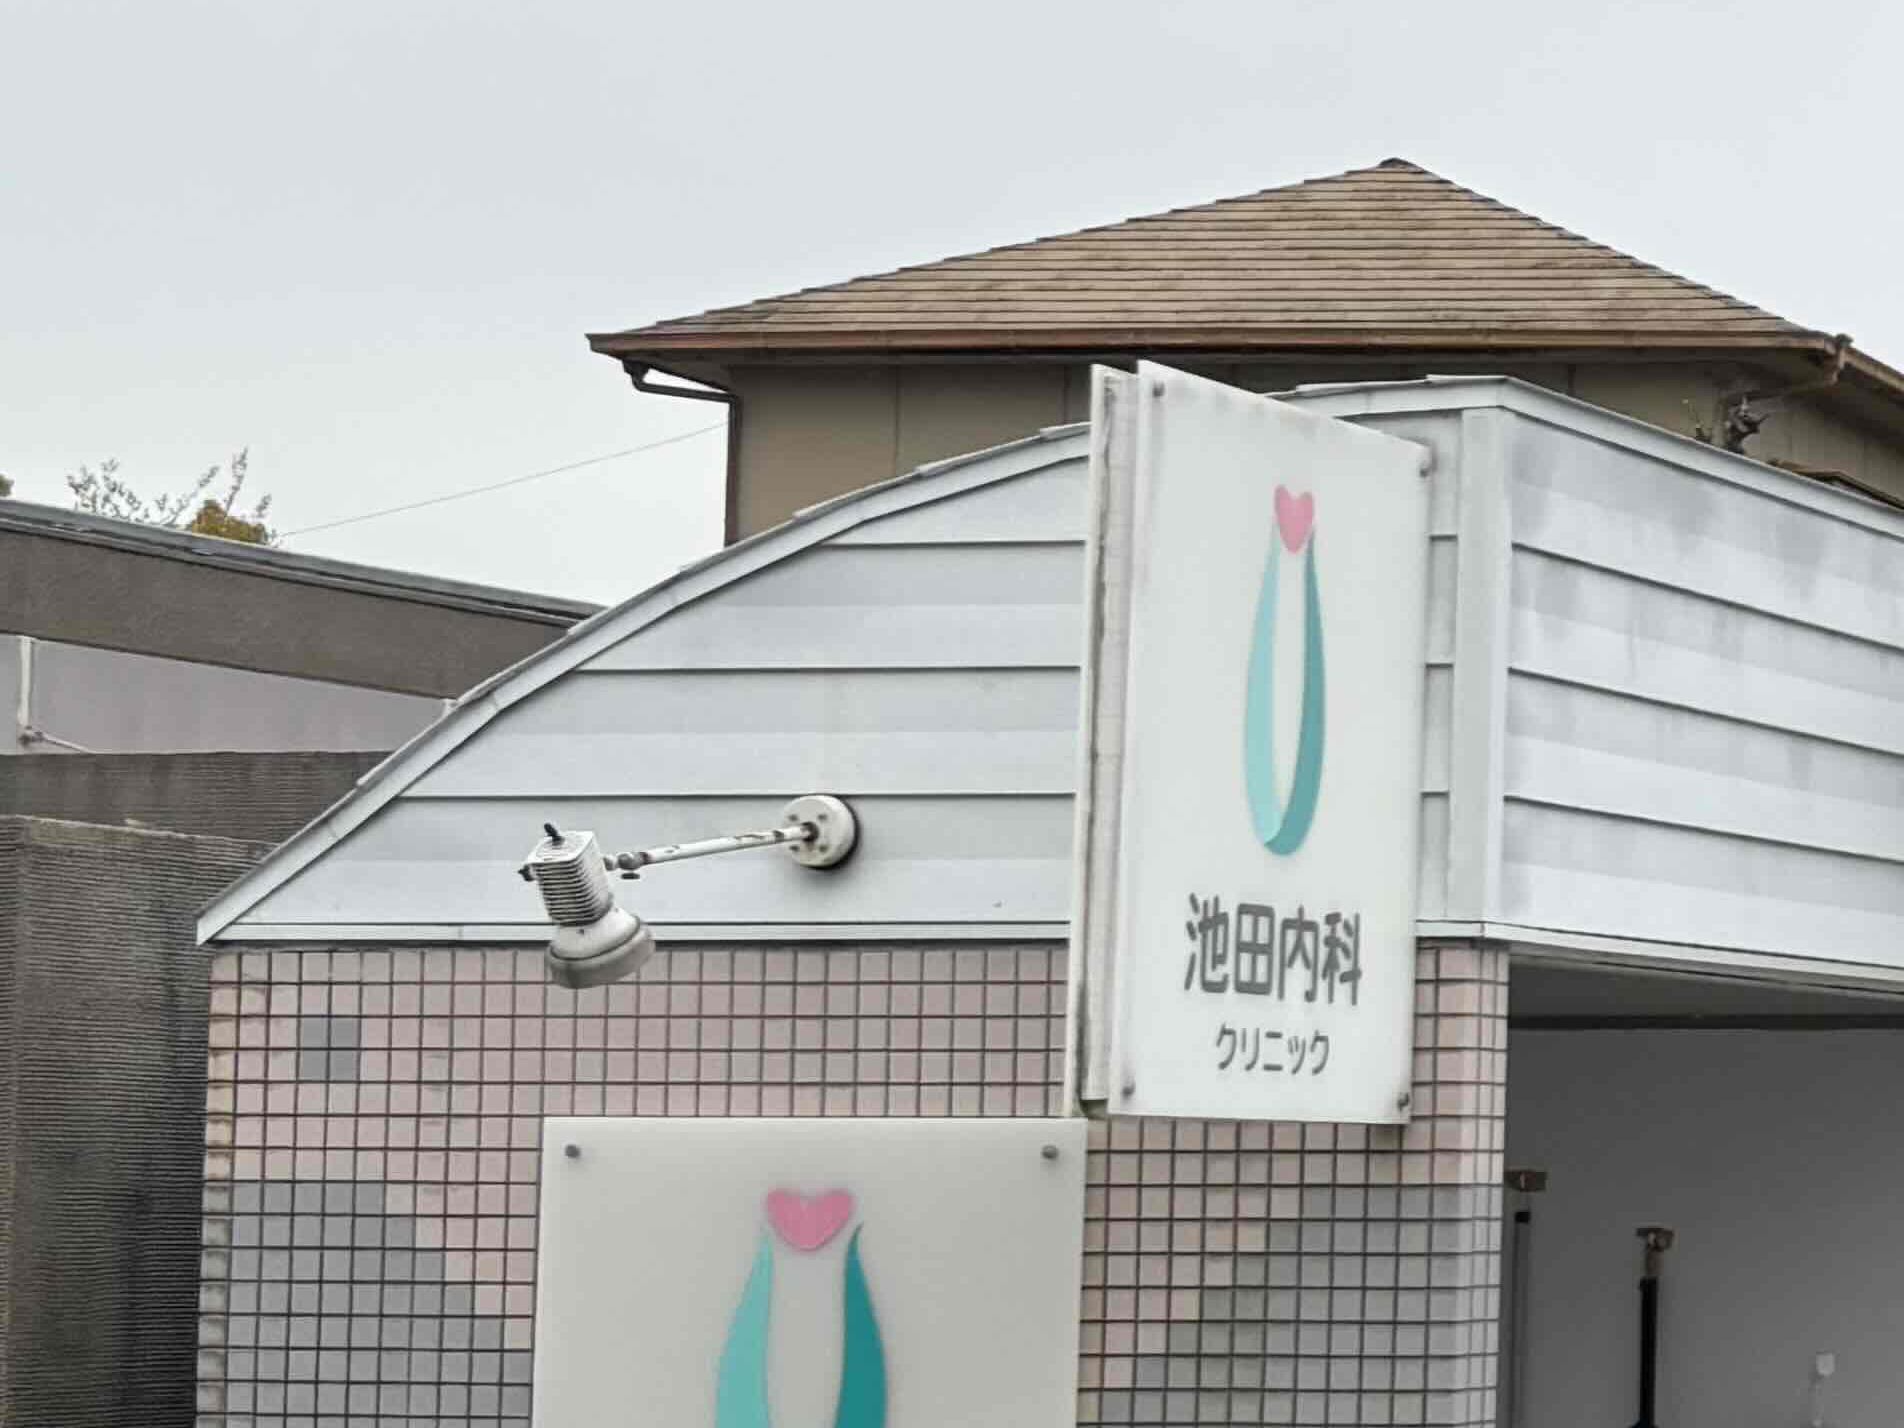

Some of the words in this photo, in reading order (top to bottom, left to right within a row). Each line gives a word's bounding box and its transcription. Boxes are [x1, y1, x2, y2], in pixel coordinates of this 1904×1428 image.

[1183, 892, 1363, 1006] 池田内科
[1215, 1022, 1330, 1075] クリニック
